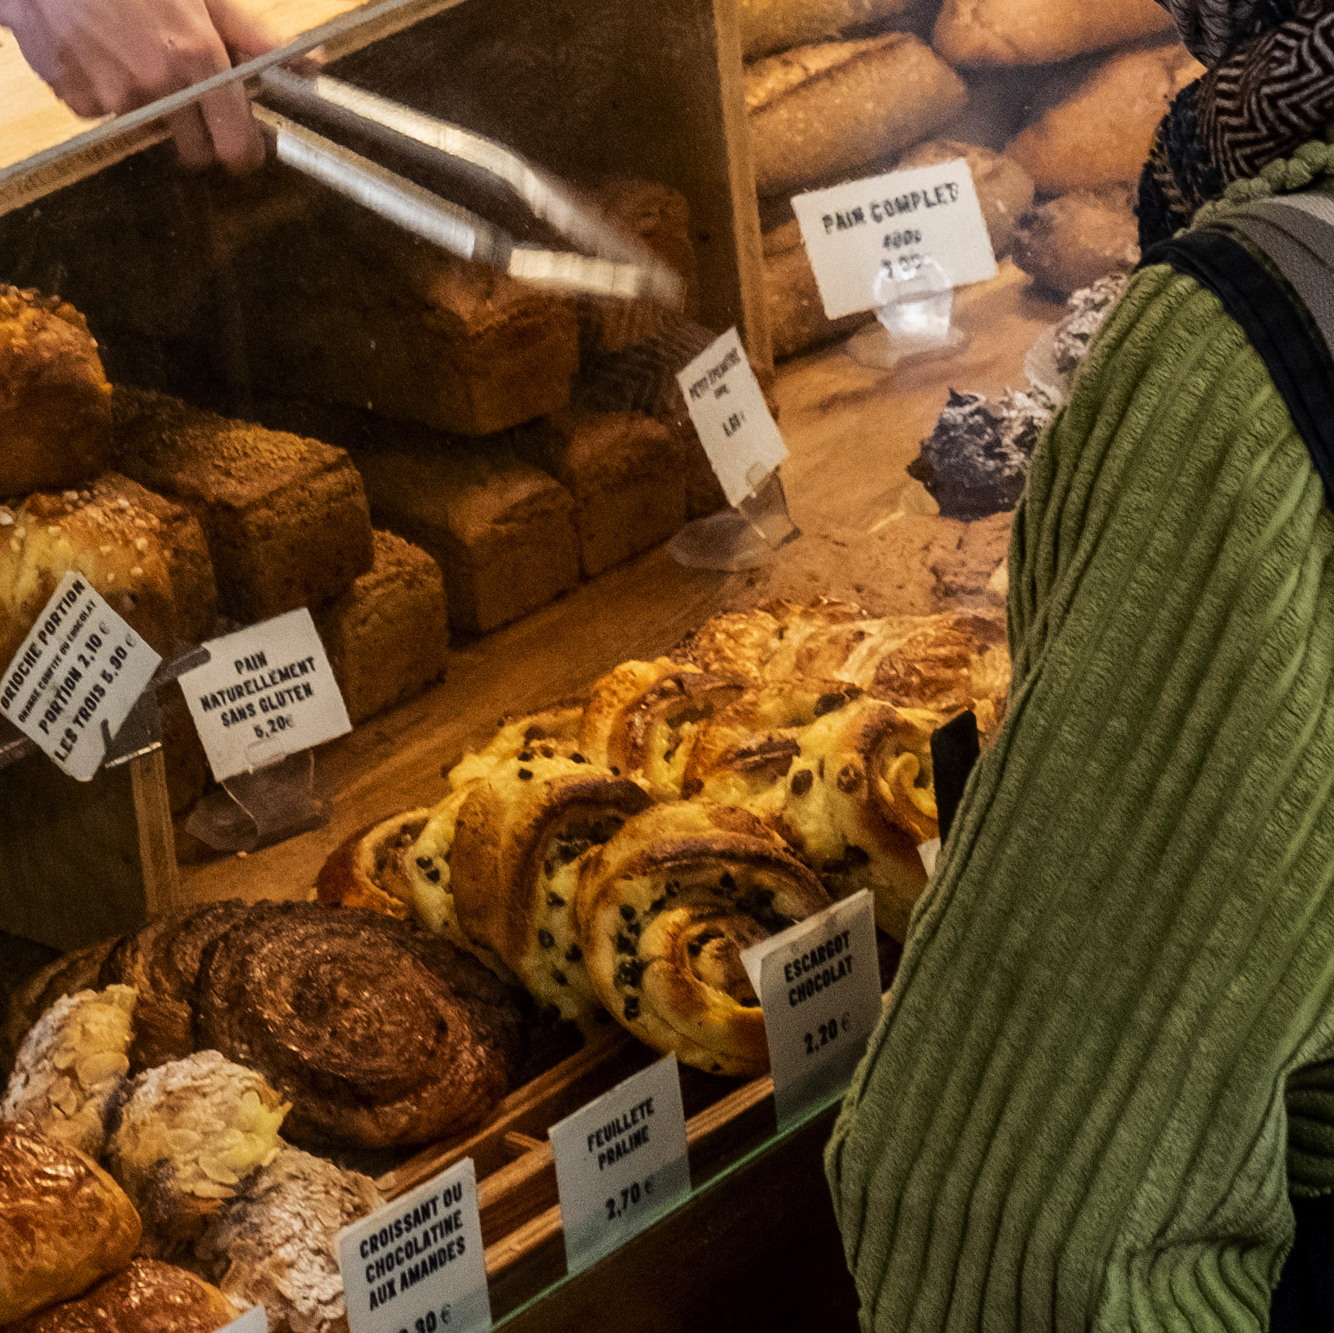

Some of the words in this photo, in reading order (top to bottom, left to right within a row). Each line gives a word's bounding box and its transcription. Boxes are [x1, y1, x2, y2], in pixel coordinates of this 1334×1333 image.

[821, 206, 867, 235] PAIN
[869, 182, 960, 224] COMPLET
[38, 579, 86, 641] PORTION
[38, 669, 83, 735] PORTION
[78, 633, 104, 668] 2,10
[199, 657, 316, 712] NATURELLEMENT
[234, 651, 268, 675] PAIN
[54, 729, 78, 763] LES
[74, 684, 107, 731] TROIS
[220, 702, 257, 727] SANS
[259, 681, 315, 713] GLUTEN
[783, 929, 851, 983] ESCARGOT
[788, 954, 854, 1008] CHOCOLAT
[803, 1018, 839, 1055] 2,20
[586, 1097, 655, 1152] FEUILLETE
[597, 1125, 650, 1171] PRALINE
[359, 1197, 441, 1261] CROISSANT
[442, 1181, 464, 1209] OU
[604, 1181, 641, 1221] 2,70
[365, 1208, 464, 1285] CHOCOLATINE
[369, 1278, 398, 1312] AUX
[399, 1234, 467, 1298] AMANDES
